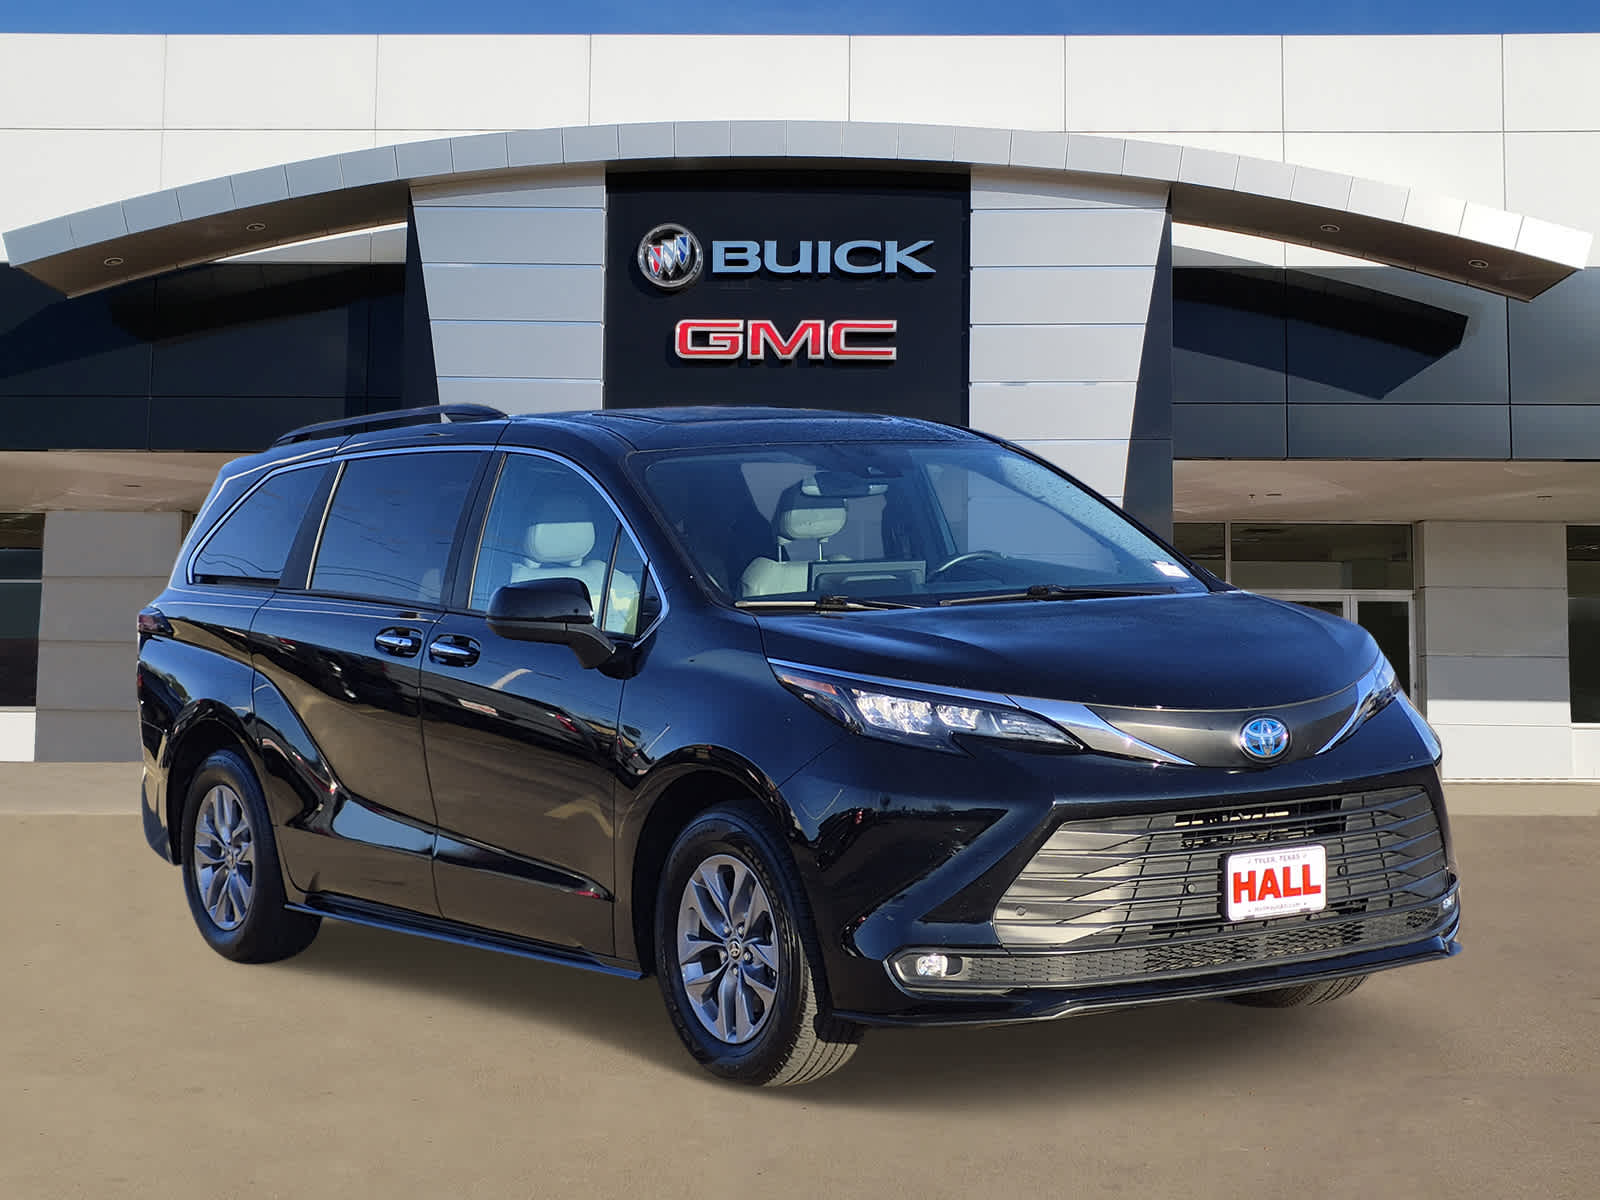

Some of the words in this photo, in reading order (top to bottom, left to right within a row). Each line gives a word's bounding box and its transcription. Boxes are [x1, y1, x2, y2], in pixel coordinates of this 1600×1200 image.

[711, 240, 937, 274] BUICK
[674, 319, 898, 360] GMC
[1279, 853, 1301, 862] TEXAS
[1233, 864, 1321, 904] HALL
